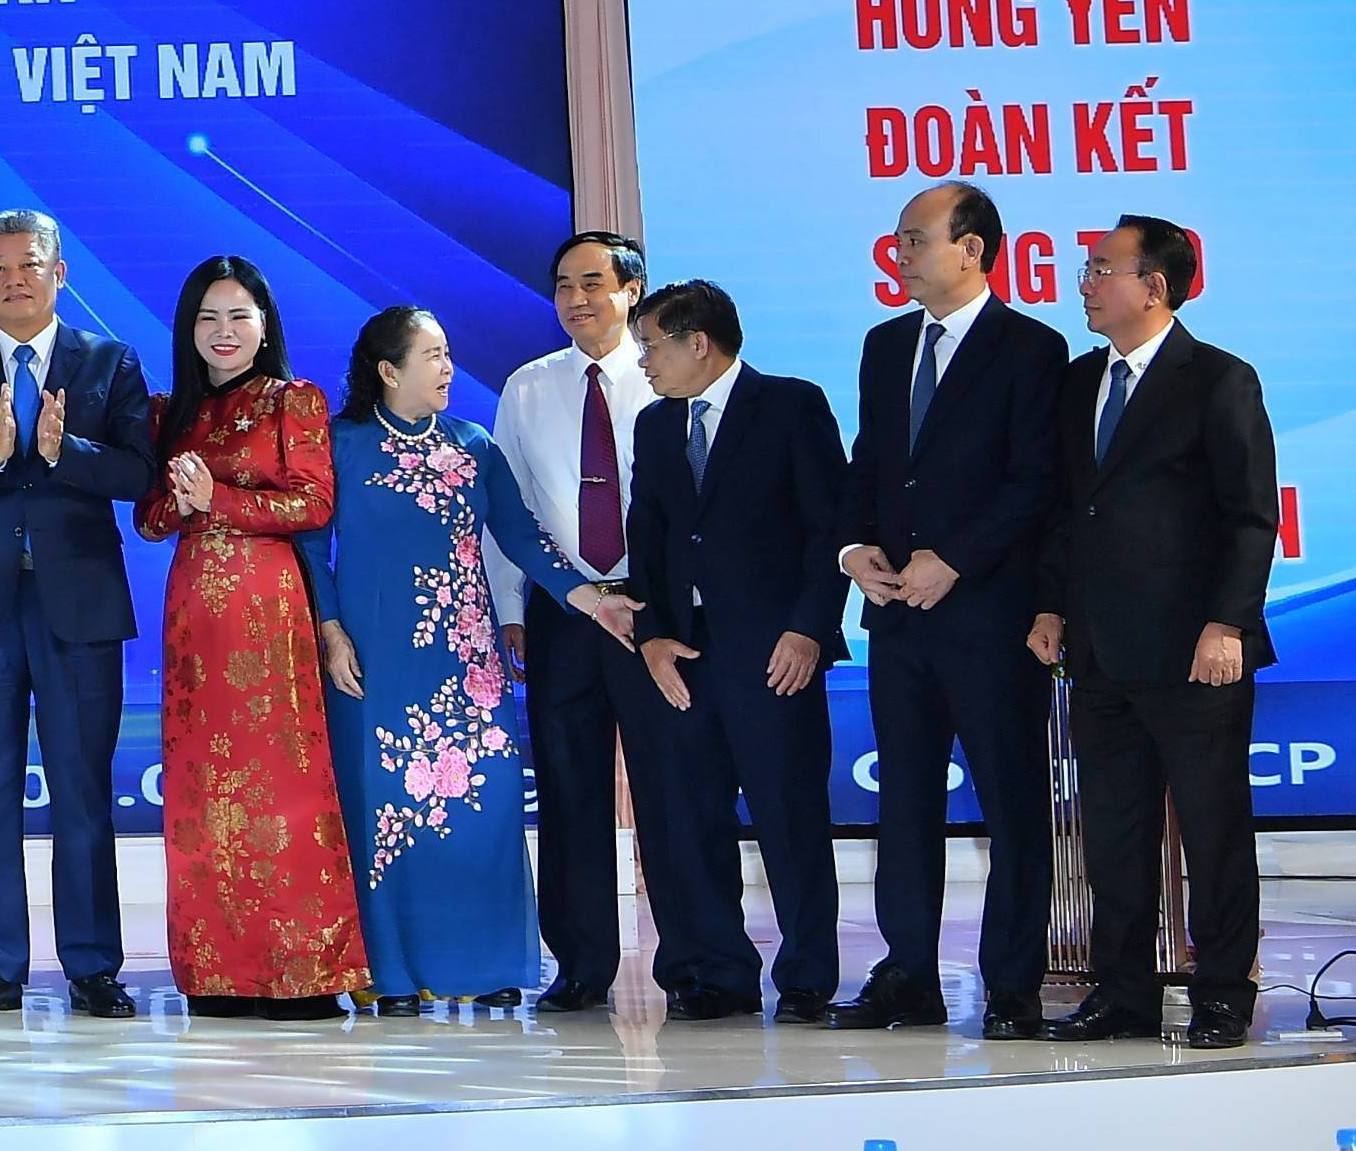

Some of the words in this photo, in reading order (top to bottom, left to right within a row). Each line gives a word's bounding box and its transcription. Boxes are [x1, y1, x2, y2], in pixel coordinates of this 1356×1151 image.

[13, 33, 138, 114] VIỆT
[158, 41, 297, 100] NAM
[865, 88, 1052, 179] ĐOÀN
[1073, 77, 1194, 174] KẾT
[873, 230, 1057, 307] SG
